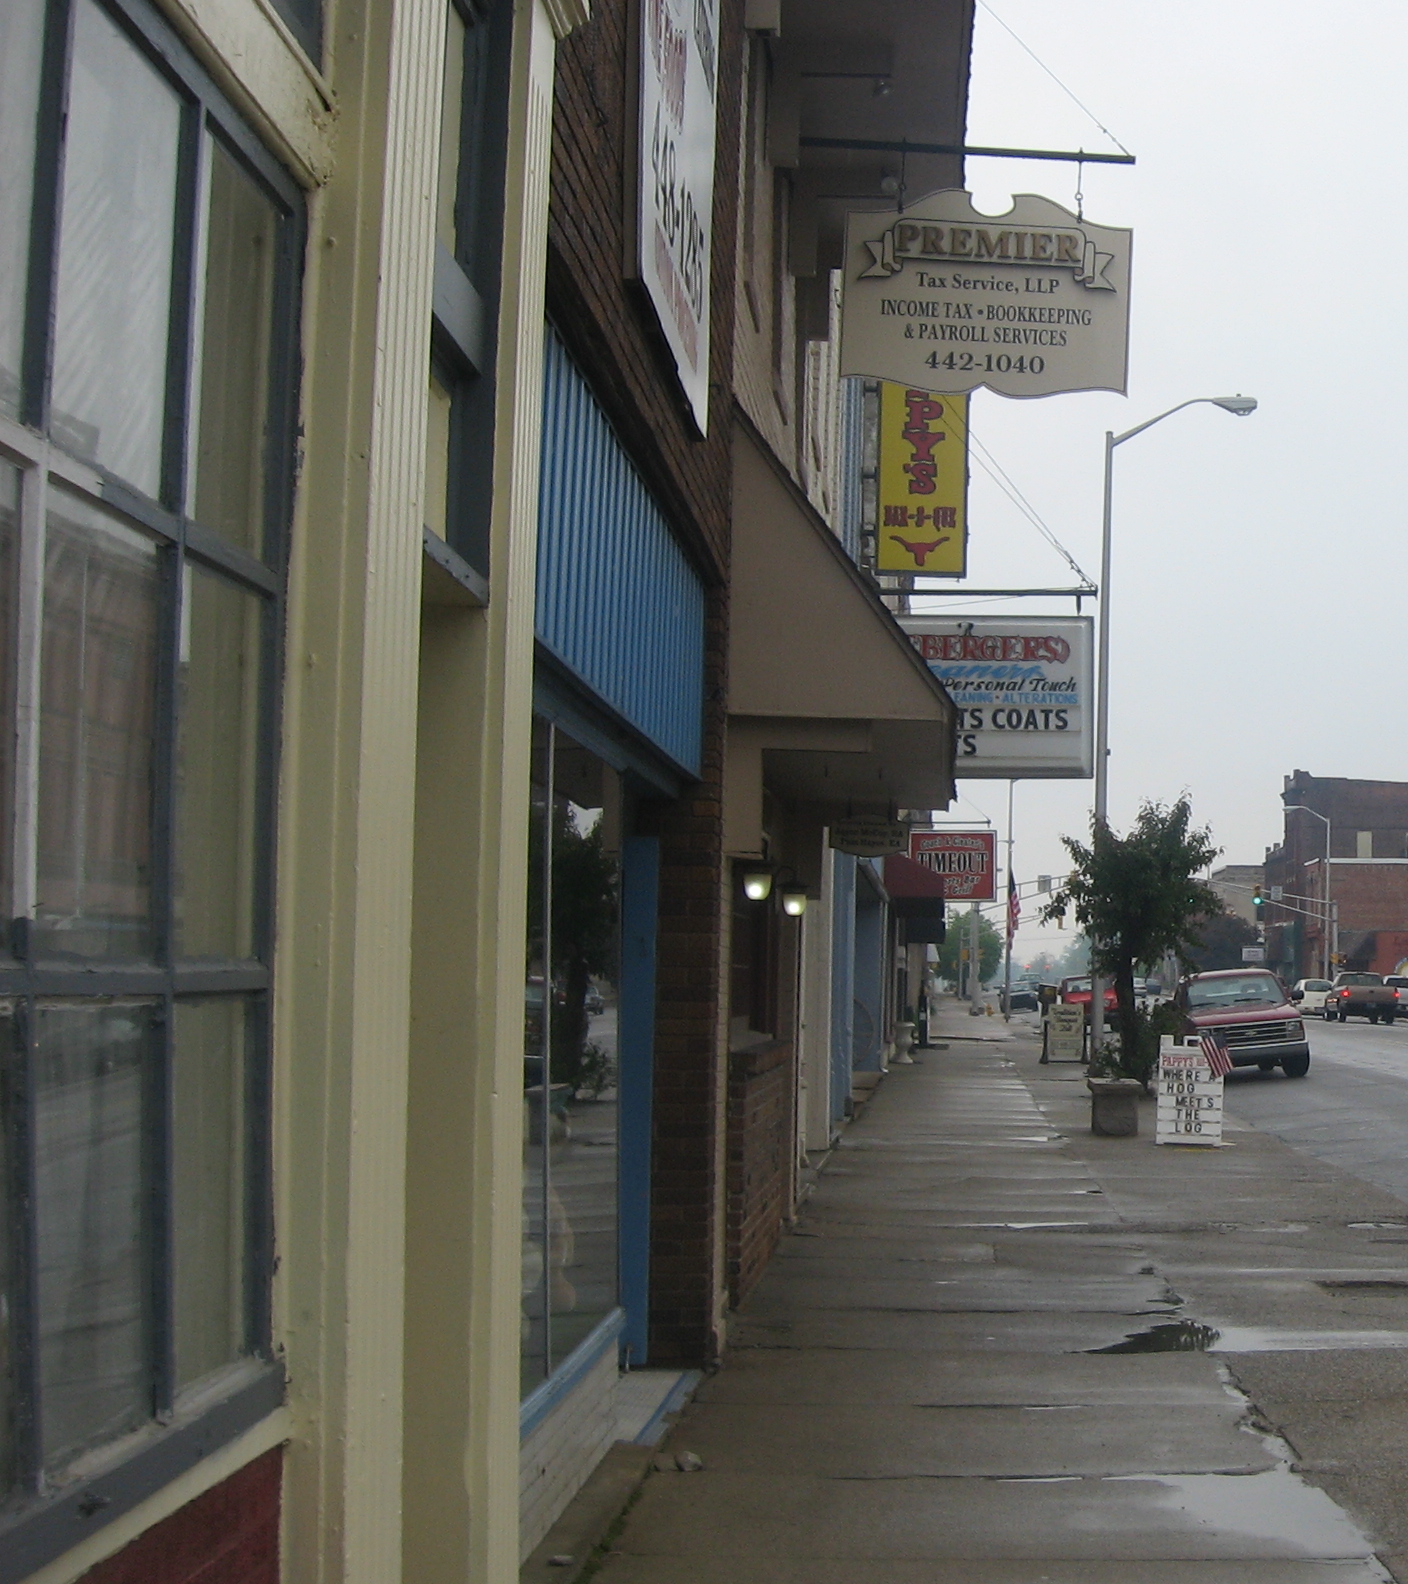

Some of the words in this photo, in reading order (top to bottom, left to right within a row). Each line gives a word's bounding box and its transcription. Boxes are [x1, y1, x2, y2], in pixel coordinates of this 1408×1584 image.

[896, 223, 1082, 263] PREMIER
[917, 271, 946, 290] Tax
[952, 274, 1019, 295] Service,
[1025, 278, 1060, 294] LLP
[881, 299, 939, 318] INCOME
[944, 302, 973, 320] TAX
[987, 305, 1092, 326] BOOKKEEPING
[904, 323, 915, 340] &
[919, 323, 989, 343] PAYROLL
[993, 327, 1068, 347] SERVICES
[925, 351, 1045, 374] 442-1040
[1029, 675, 1077, 693] Touch
[1004, 692, 1079, 705] ALTERATIONS
[991, 708, 1068, 730] COATS
[917, 851, 988, 874] TIMEOUT
[1163, 1070, 1201, 1082] WHERE
[1167, 1082, 1195, 1094] HOG
[1177, 1108, 1200, 1120] THE
[1175, 1122, 1202, 1133] LOG
